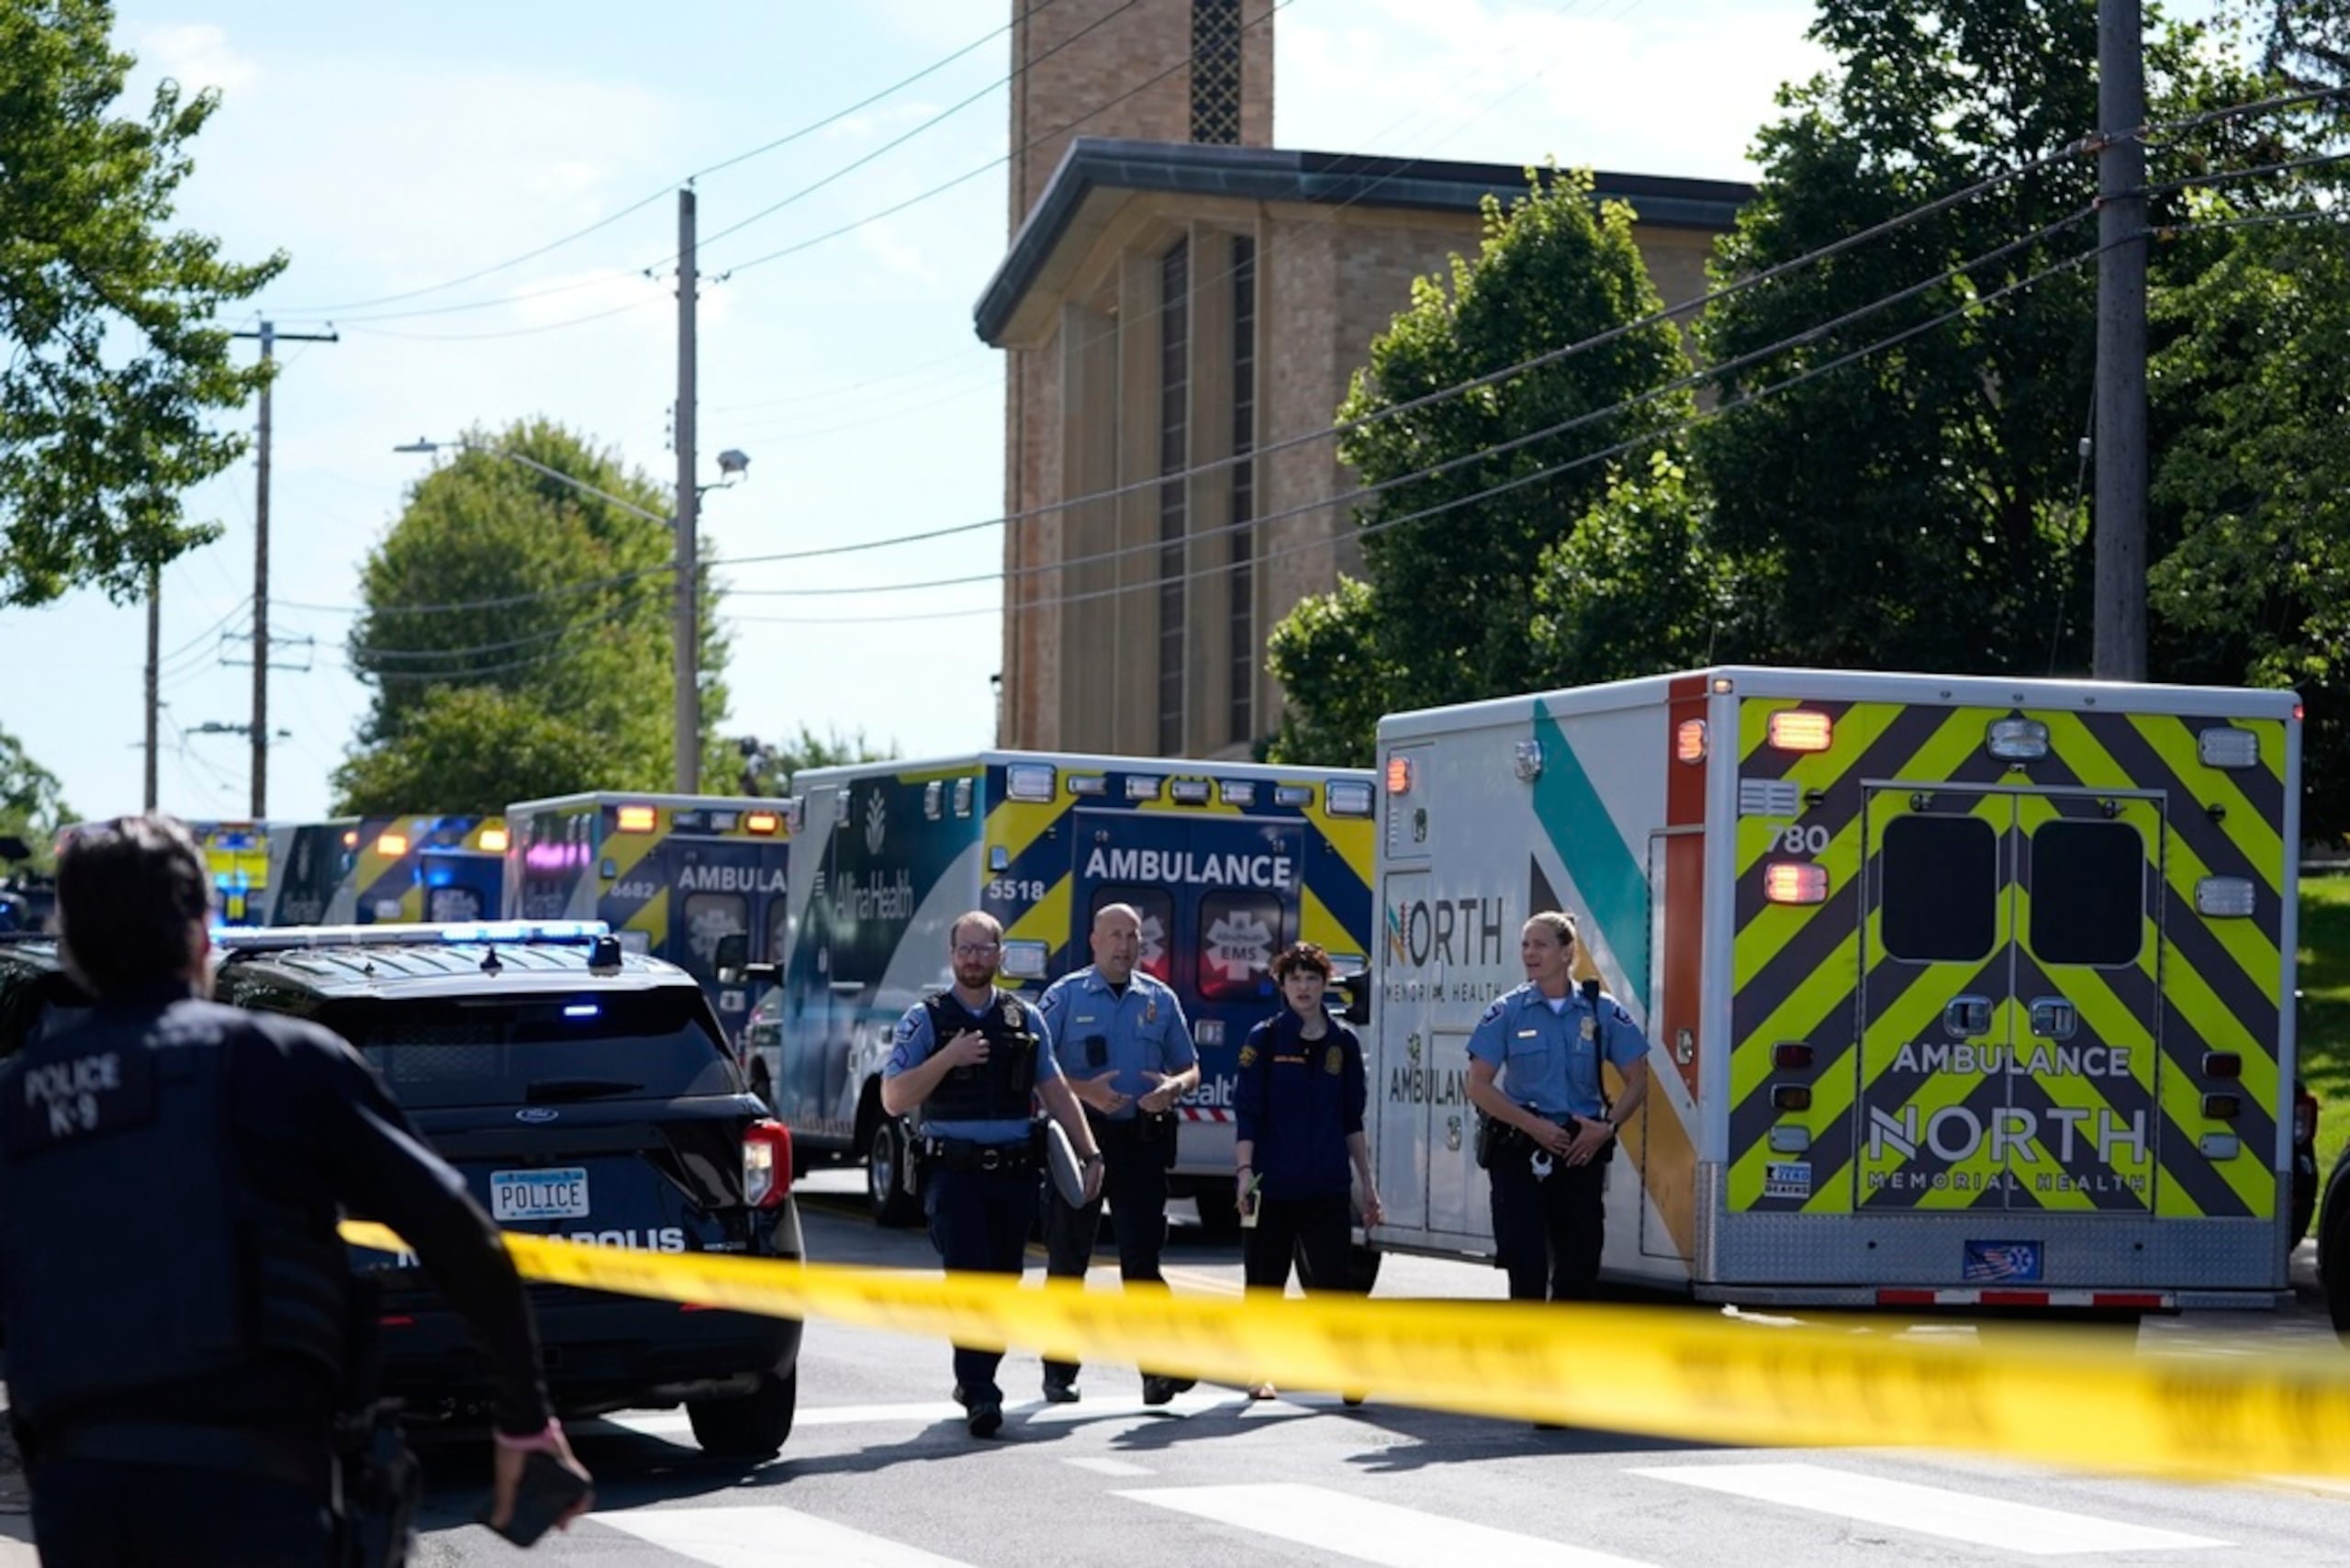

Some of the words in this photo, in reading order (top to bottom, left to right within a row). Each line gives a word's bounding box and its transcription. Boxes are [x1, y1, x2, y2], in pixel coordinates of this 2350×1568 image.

[1767, 823, 1830, 854] 780
[1084, 847, 1292, 888] AMBULANCE
[610, 881, 655, 898] 6682
[988, 879, 1045, 901] 5518
[1386, 896, 1502, 967] NORTH
[1221, 945, 1256, 961] EMS
[1892, 1043, 2130, 1076] AMBULANCE
[26, 1053, 120, 1107] POLICE
[1869, 1105, 2146, 1164] NORTH
[502, 1182, 581, 1209] POLICE
[1869, 1171, 2020, 1191] MEMORIAL
[2037, 1173, 2146, 1193] HEALTH
